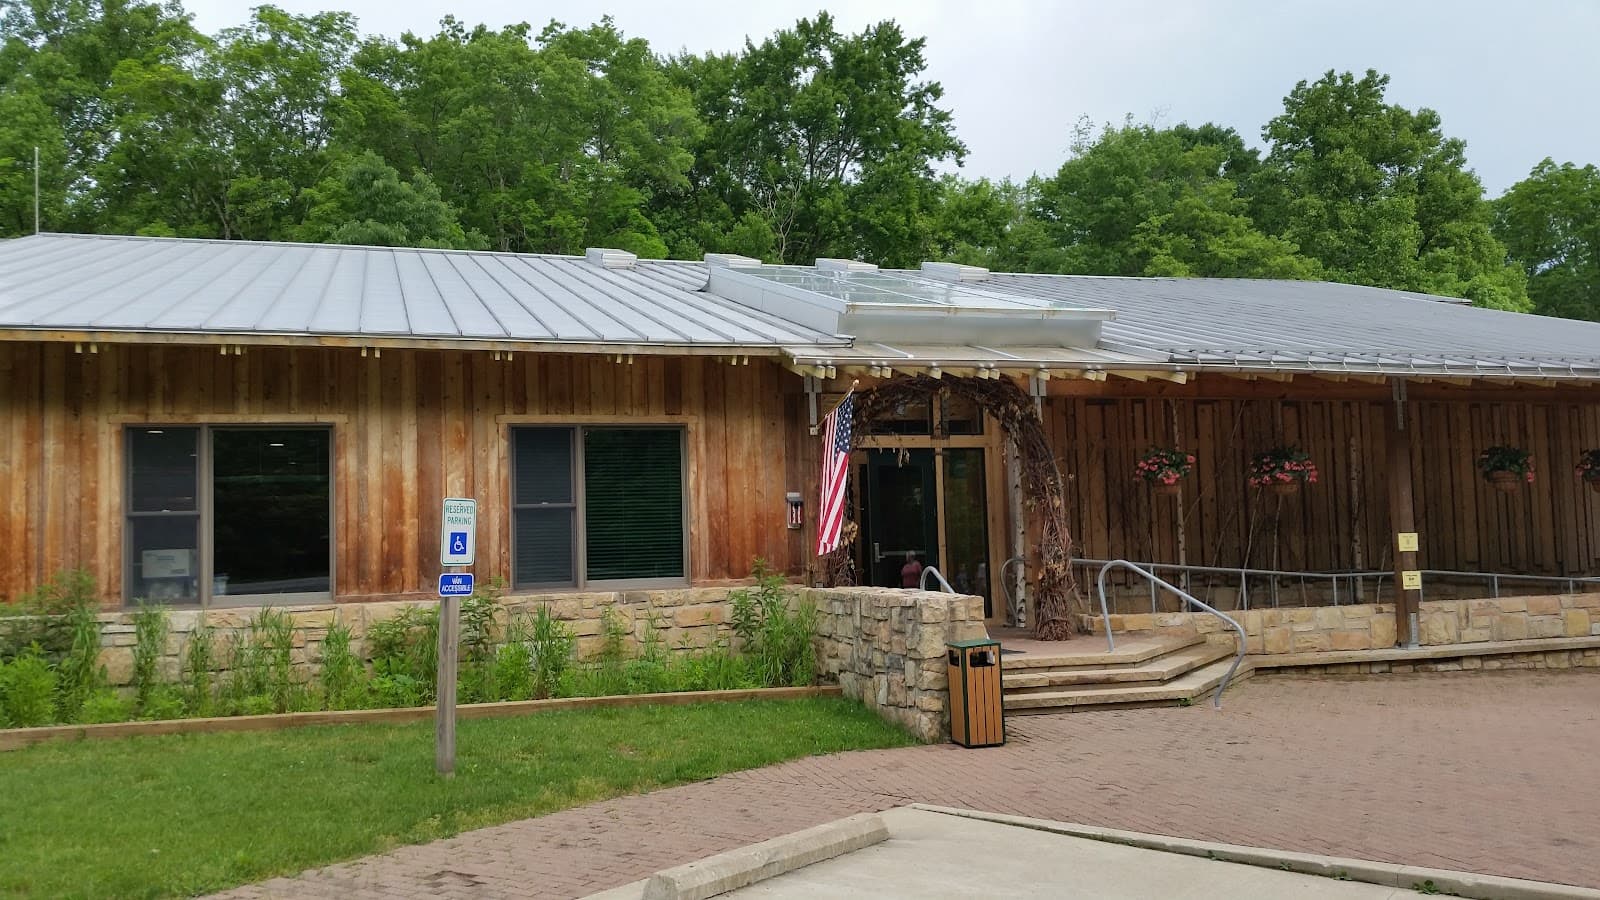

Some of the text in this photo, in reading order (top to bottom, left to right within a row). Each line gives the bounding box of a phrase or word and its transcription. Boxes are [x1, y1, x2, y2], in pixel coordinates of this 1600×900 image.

[446, 505, 473, 514] RESERVED
[447, 516, 472, 526] PARKING
[452, 577, 462, 585] VAN
[441, 584, 471, 592] ACCESSIBLE
